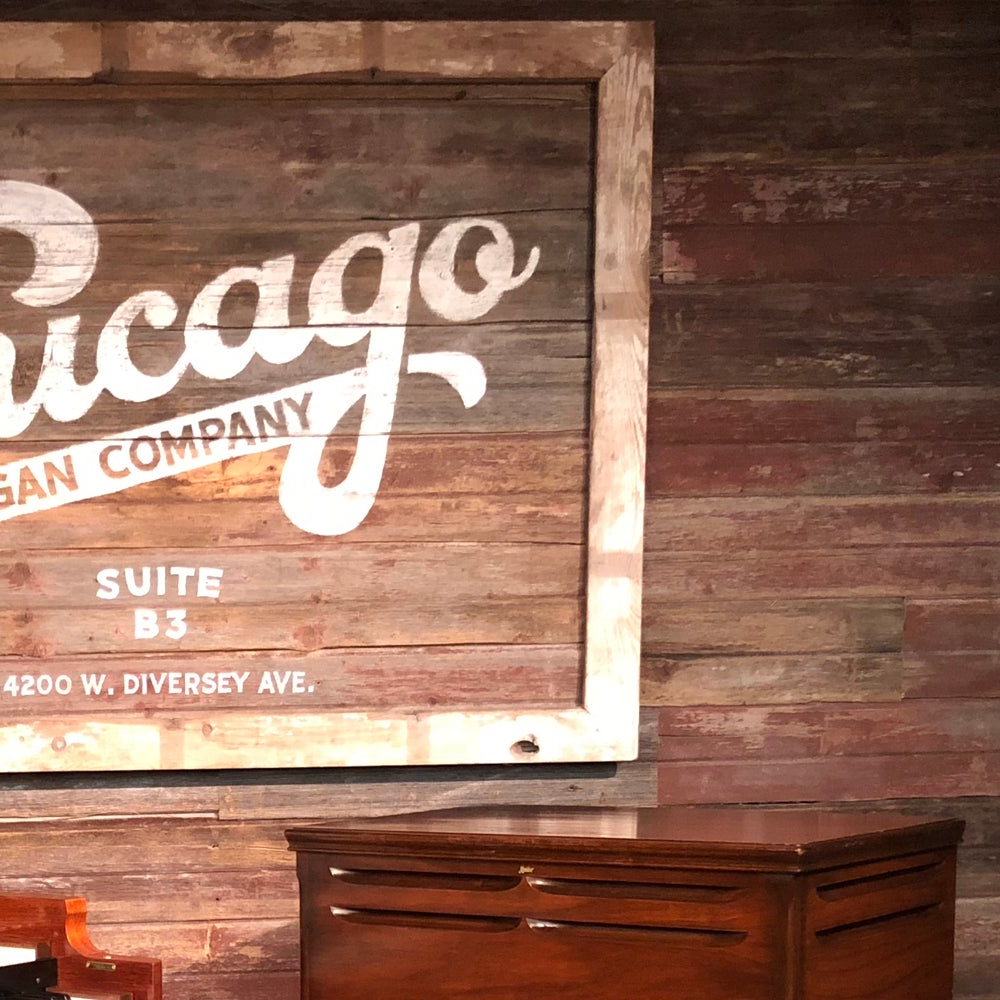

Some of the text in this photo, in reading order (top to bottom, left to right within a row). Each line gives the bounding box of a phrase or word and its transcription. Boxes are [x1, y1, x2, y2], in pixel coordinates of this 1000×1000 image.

[98, 392, 313, 480] COMPANY
[96, 565, 225, 600] SUITE
[3, 670, 315, 697] 4200 W. DIVERSEY AVE.
